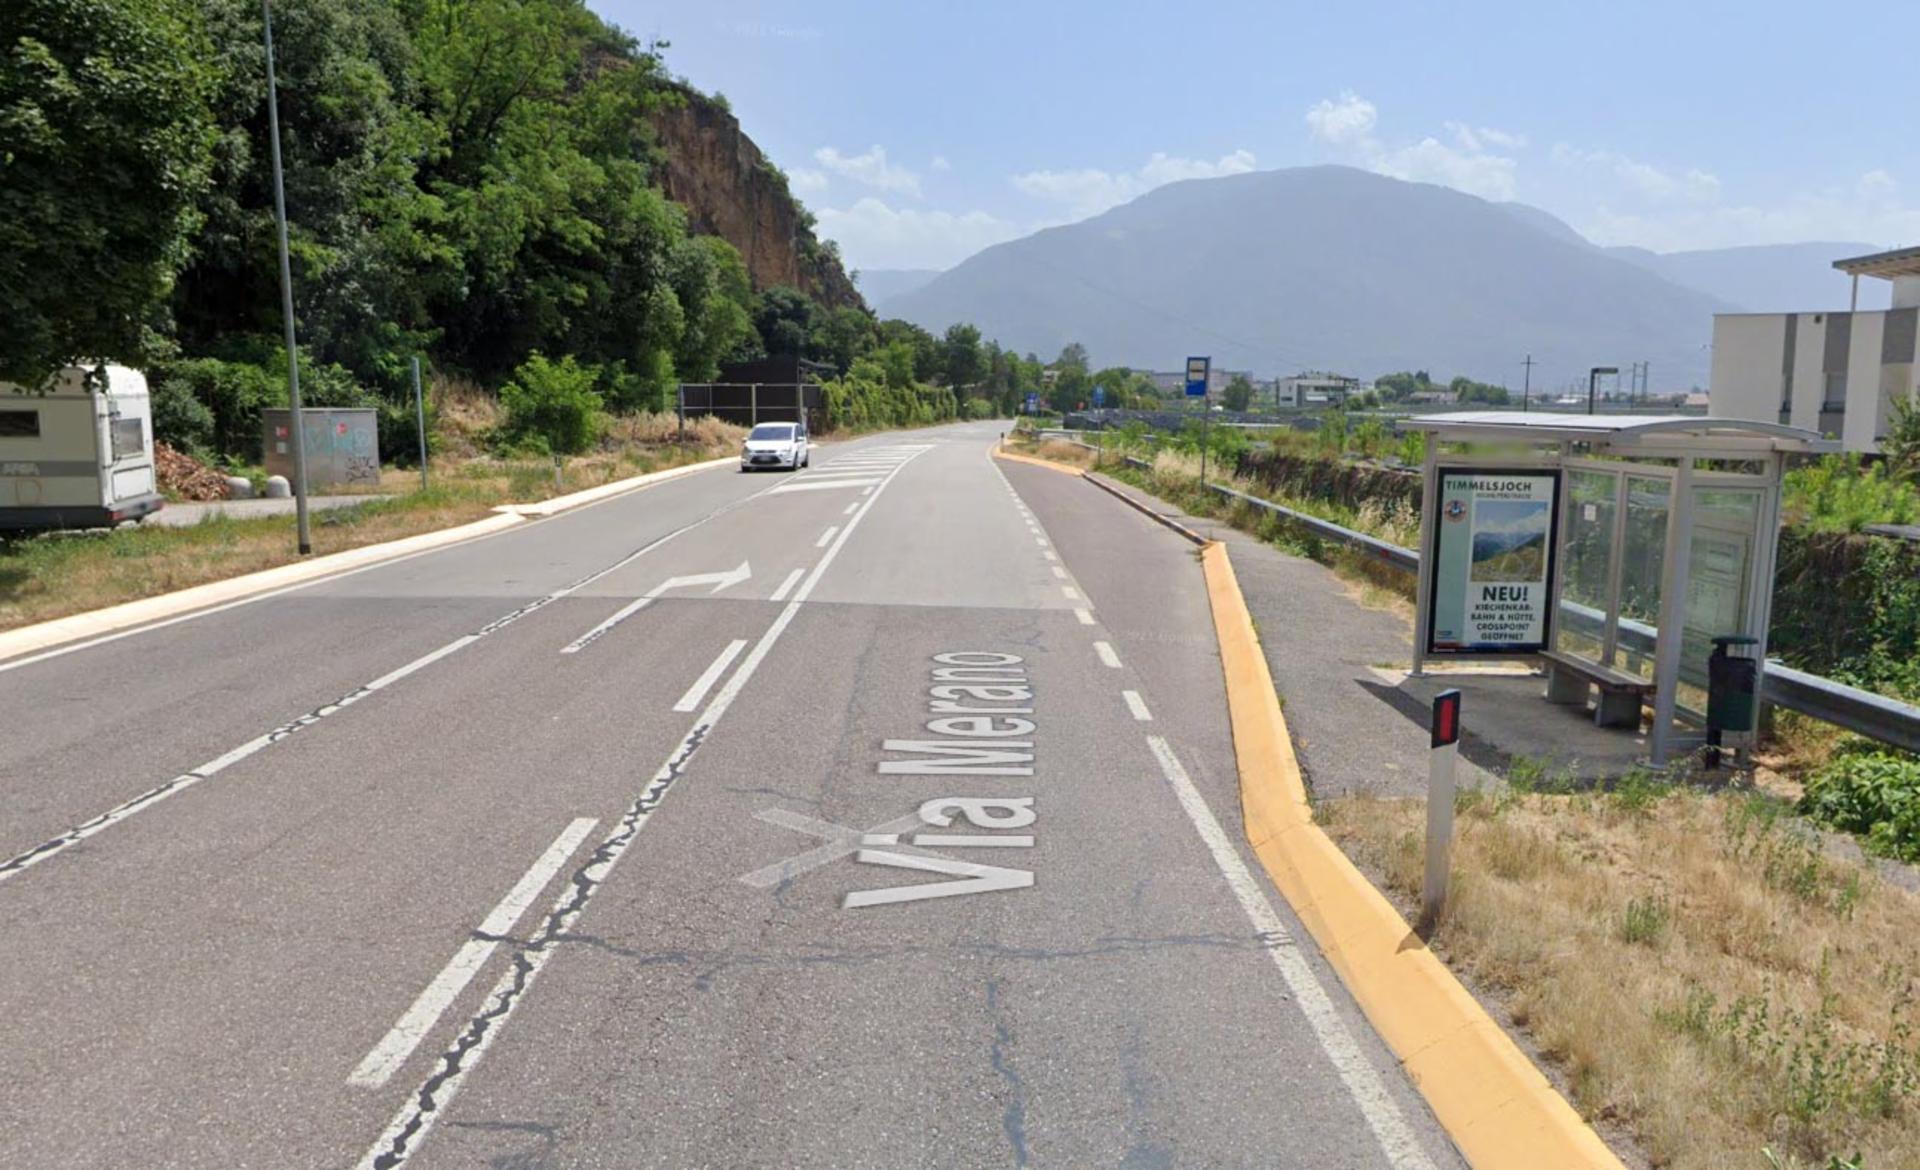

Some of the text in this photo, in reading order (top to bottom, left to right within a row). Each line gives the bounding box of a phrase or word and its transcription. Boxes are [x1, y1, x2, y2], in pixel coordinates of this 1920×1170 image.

[1446, 480, 1532, 491] TIMMELSJOCH
[1483, 586, 1528, 601] NEU!
[1471, 613, 1496, 621] BAHN
[1476, 623, 1530, 631] CROSSPOINT
